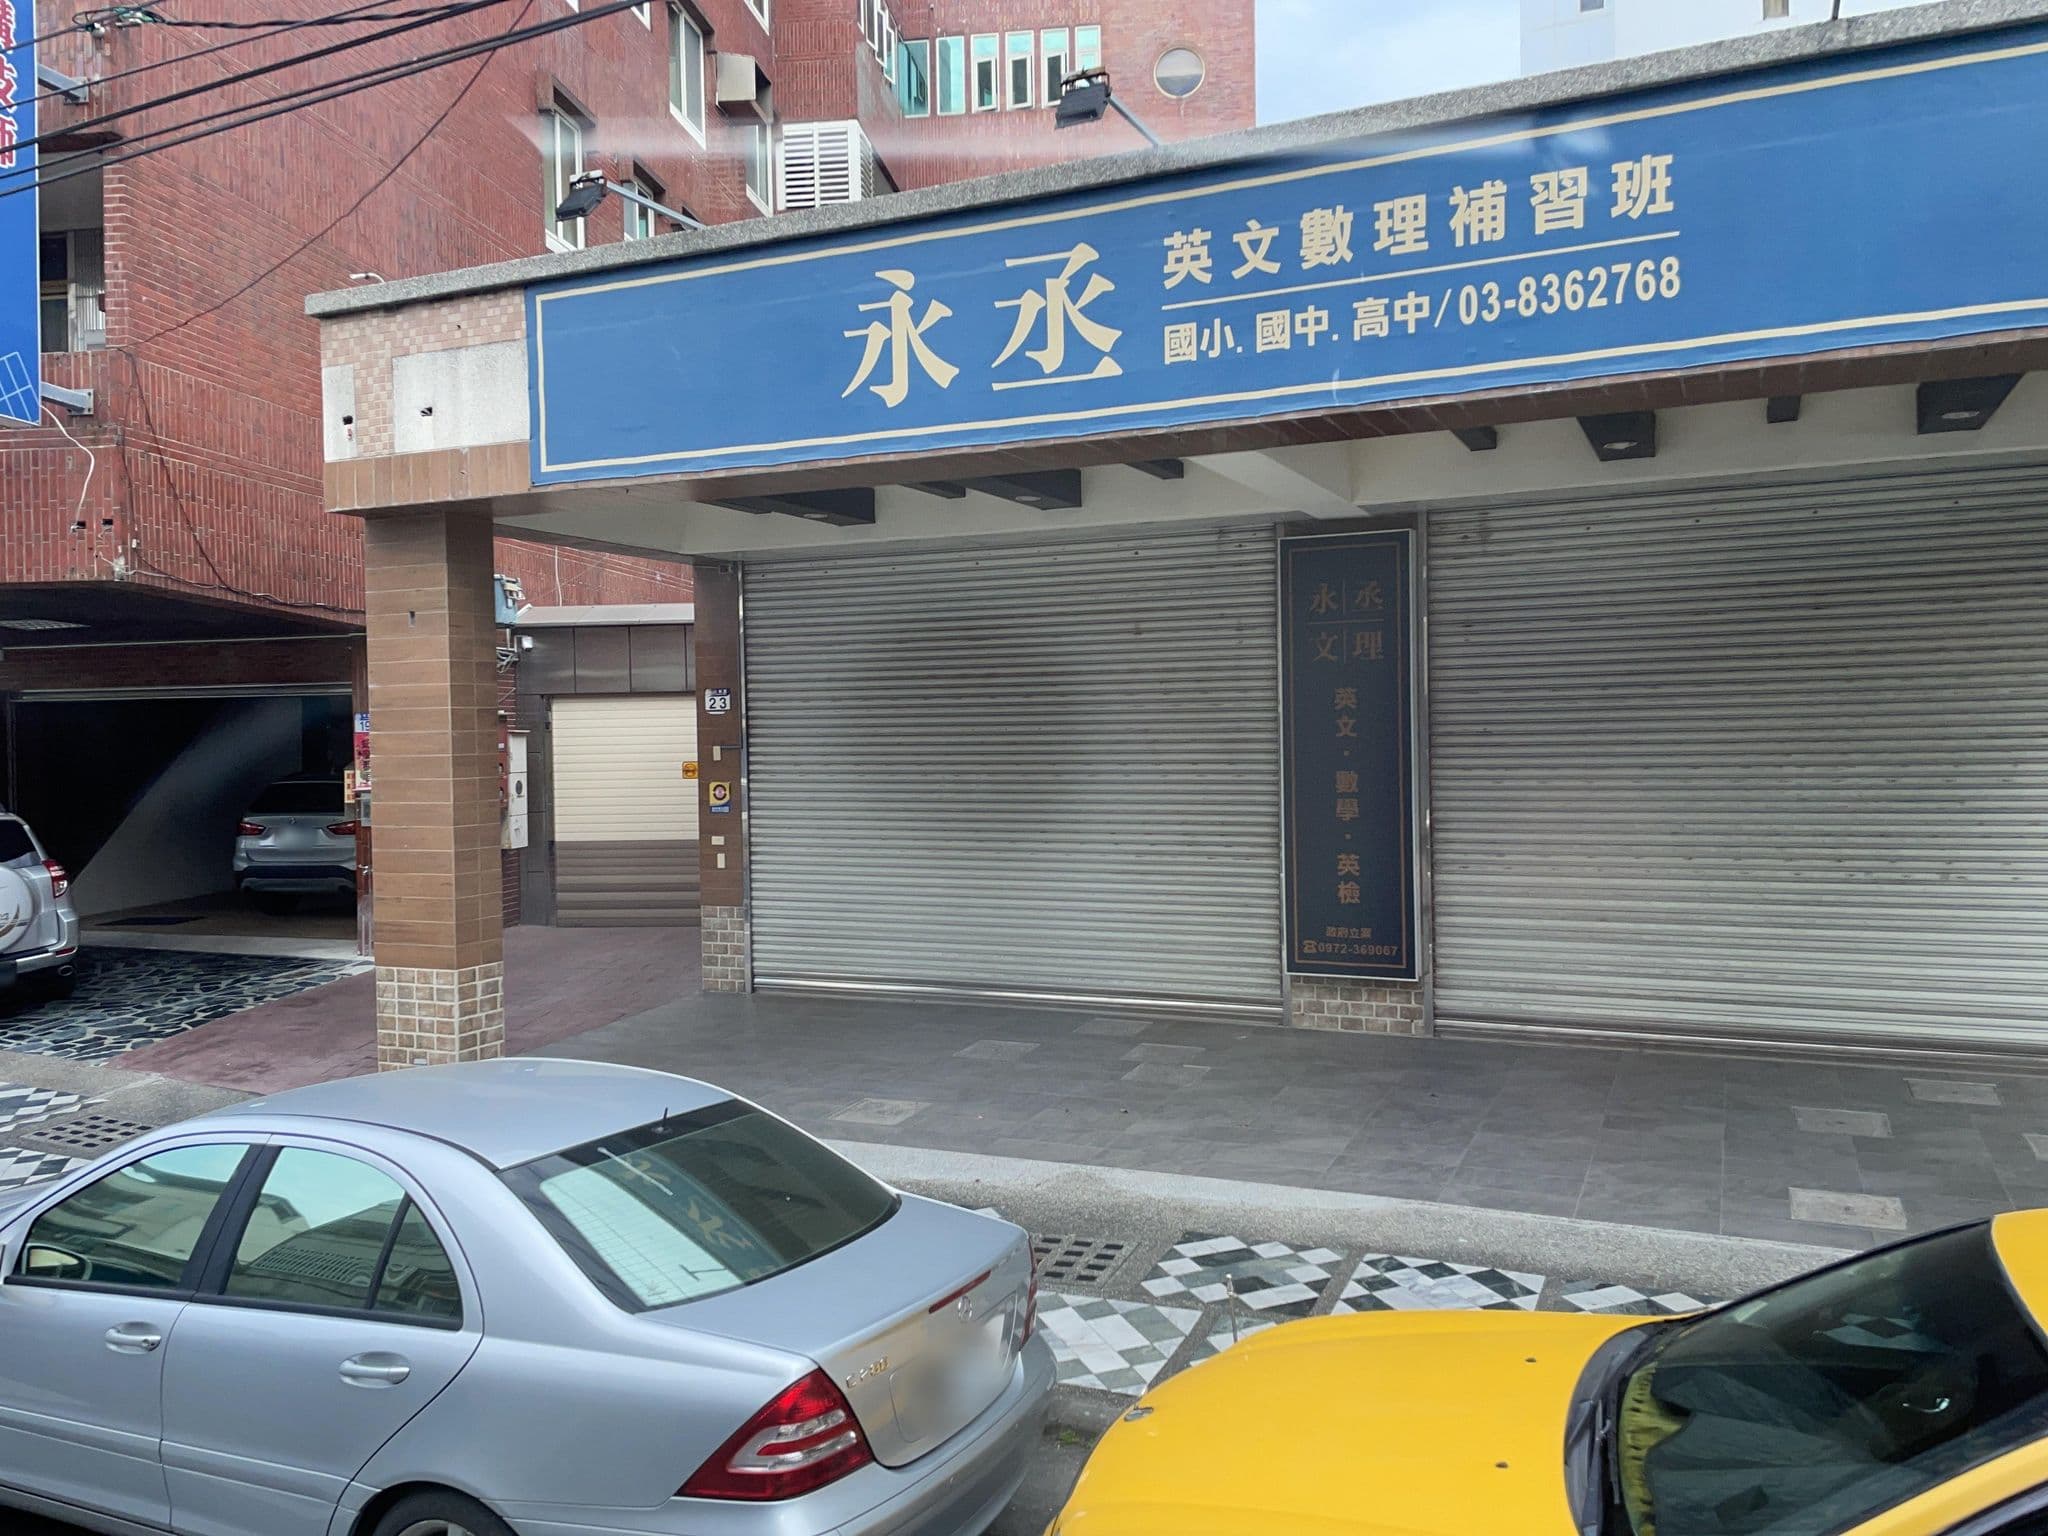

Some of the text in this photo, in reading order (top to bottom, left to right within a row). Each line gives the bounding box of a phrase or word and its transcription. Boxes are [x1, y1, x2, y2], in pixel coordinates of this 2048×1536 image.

[1163, 154, 1675, 290] 英文數理補習班
[841, 241, 1124, 409] 永丞
[708, 697, 727, 709] 23
